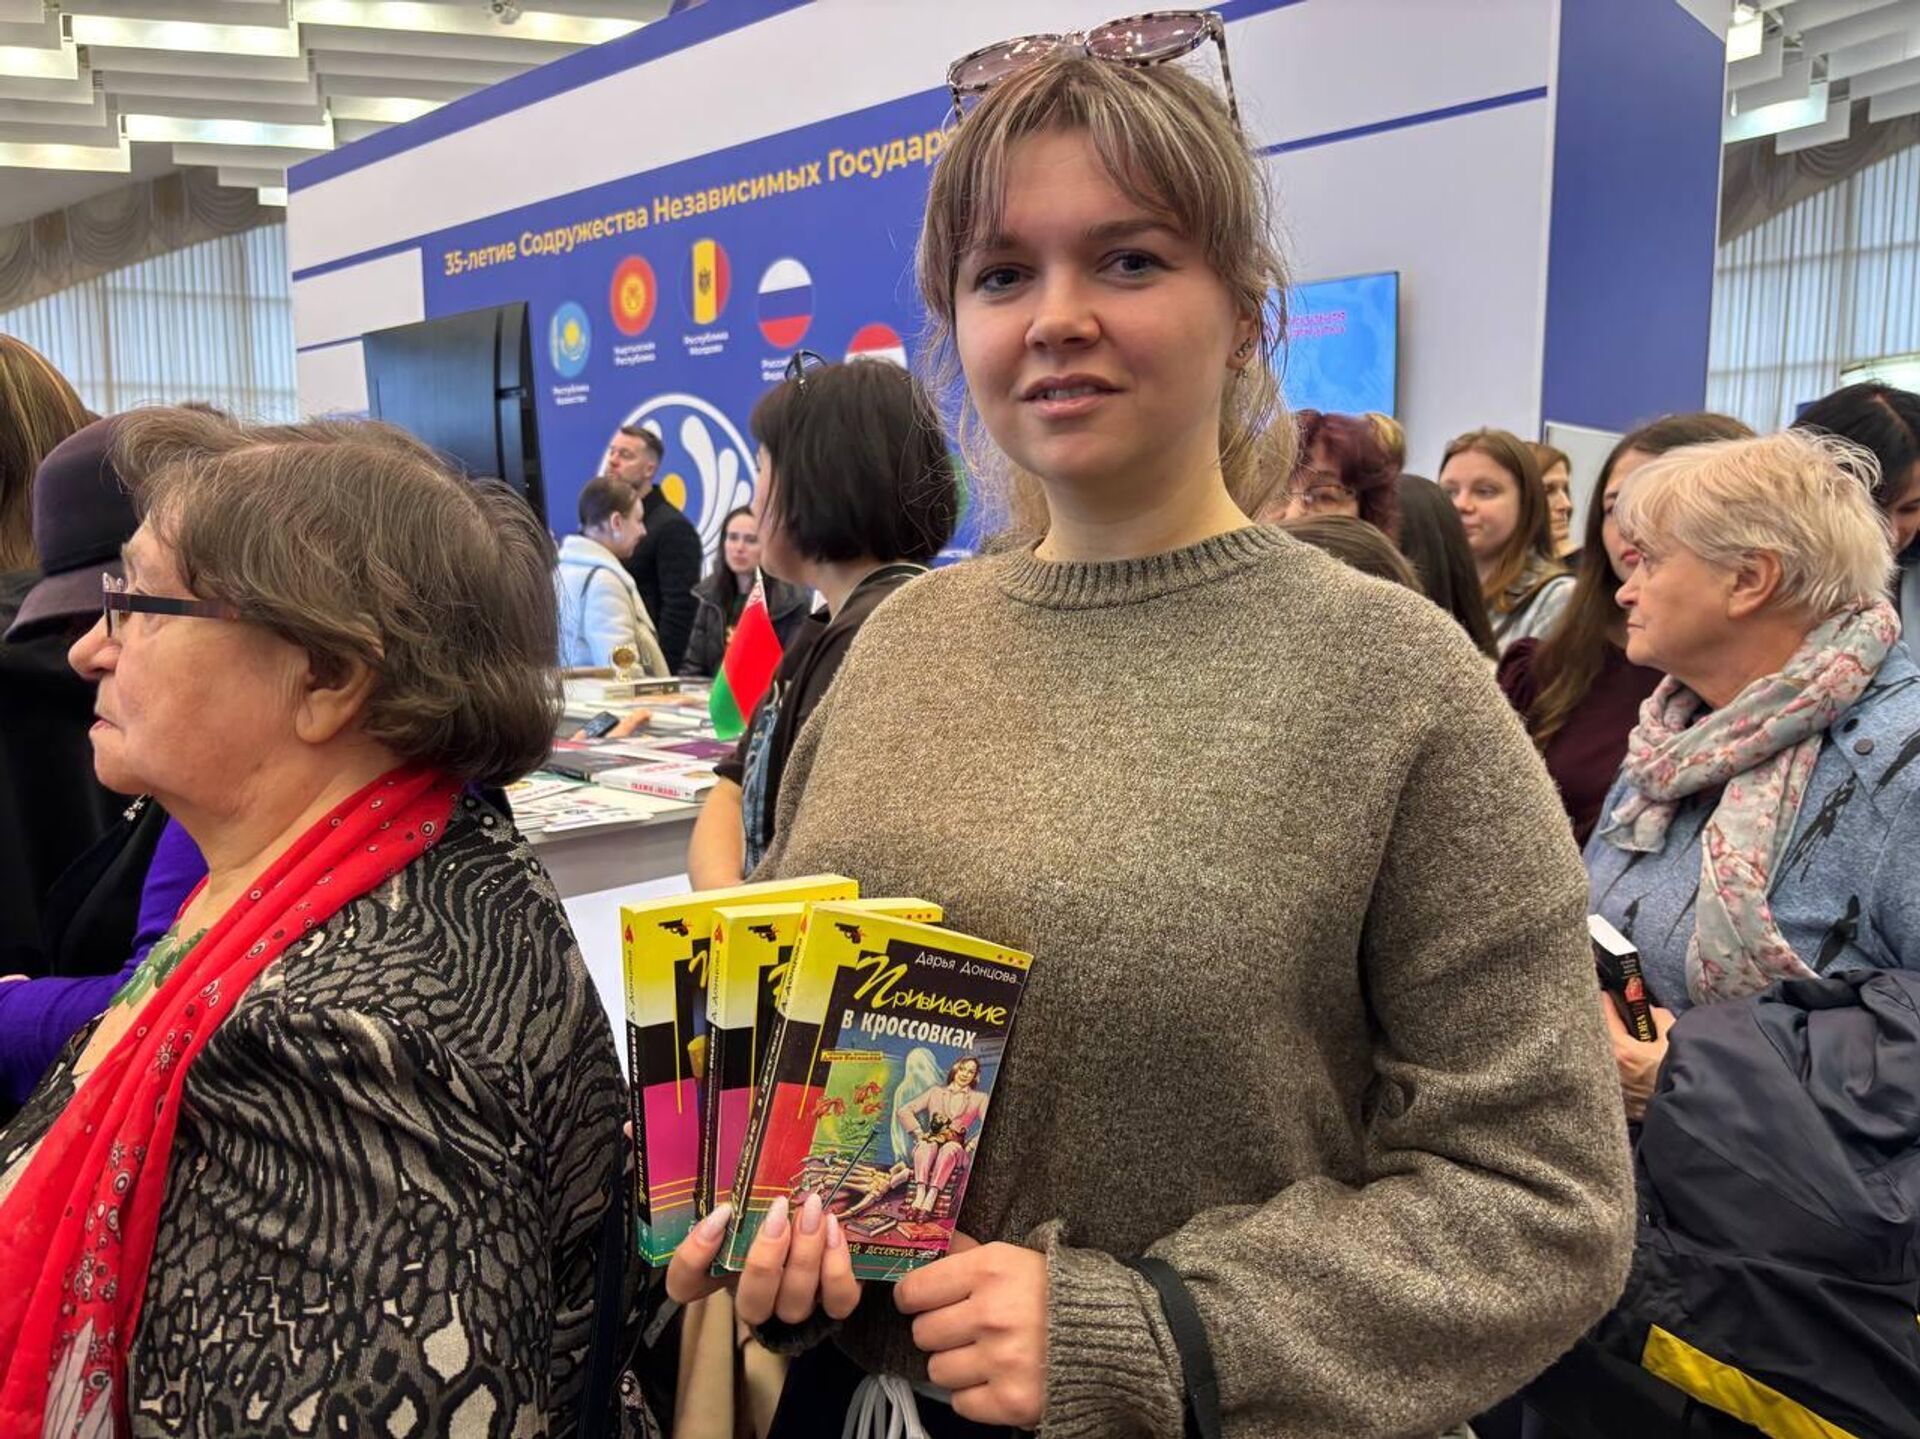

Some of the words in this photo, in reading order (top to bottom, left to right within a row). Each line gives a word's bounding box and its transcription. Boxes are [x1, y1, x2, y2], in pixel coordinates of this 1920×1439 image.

[444, 241, 517, 276] 35-летие
[519, 205, 649, 256] Содружества
[653, 161, 821, 224] Независимых
[828, 130, 944, 181] Государ
[853, 955, 1008, 1026] Привидение
[915, 951, 955, 970] Дарья
[959, 961, 1018, 984] Донцова
[840, 1009, 855, 1030] в
[860, 1011, 978, 1050] кроссовках
